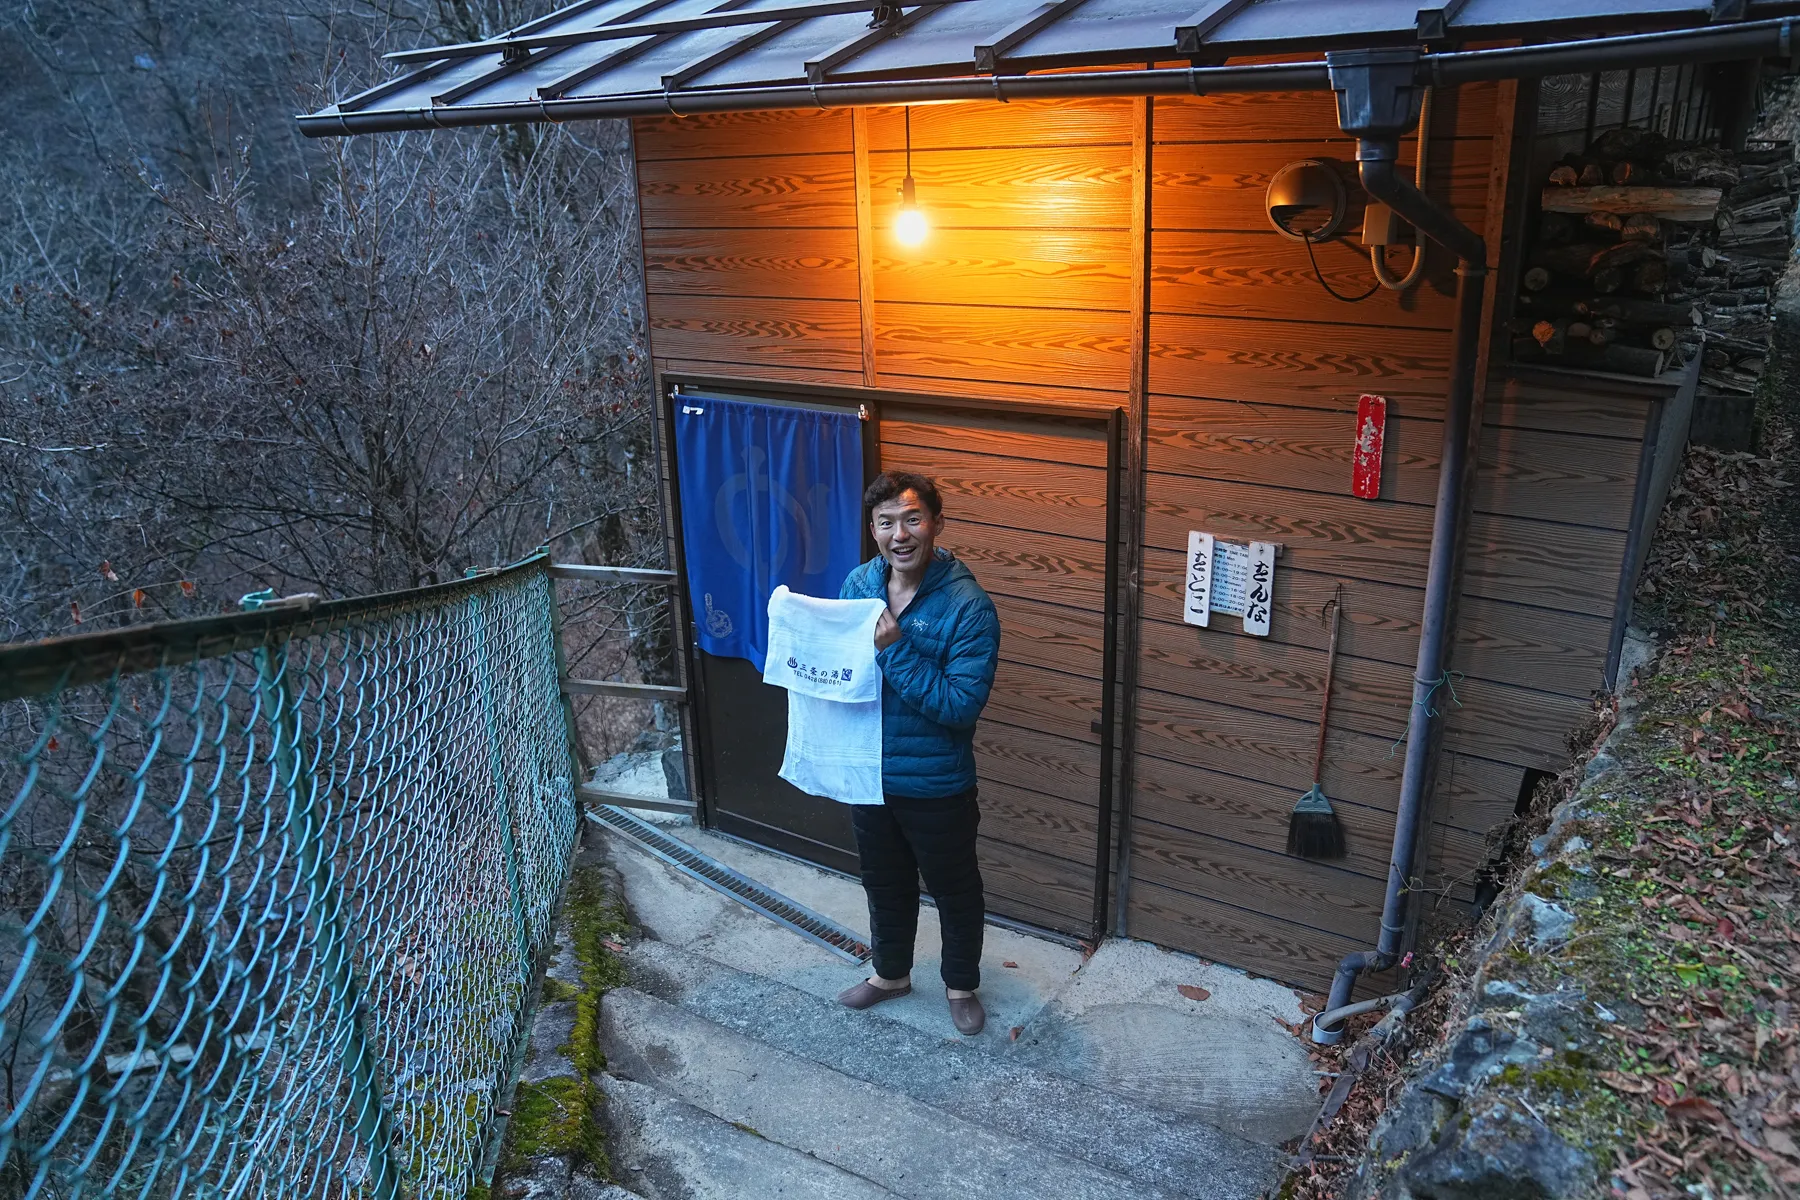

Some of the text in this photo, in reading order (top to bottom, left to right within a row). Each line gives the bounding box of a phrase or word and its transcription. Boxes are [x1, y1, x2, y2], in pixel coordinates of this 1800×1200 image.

[793, 669, 804, 678] TEL
[799, 663, 840, 679] 三条の湯
